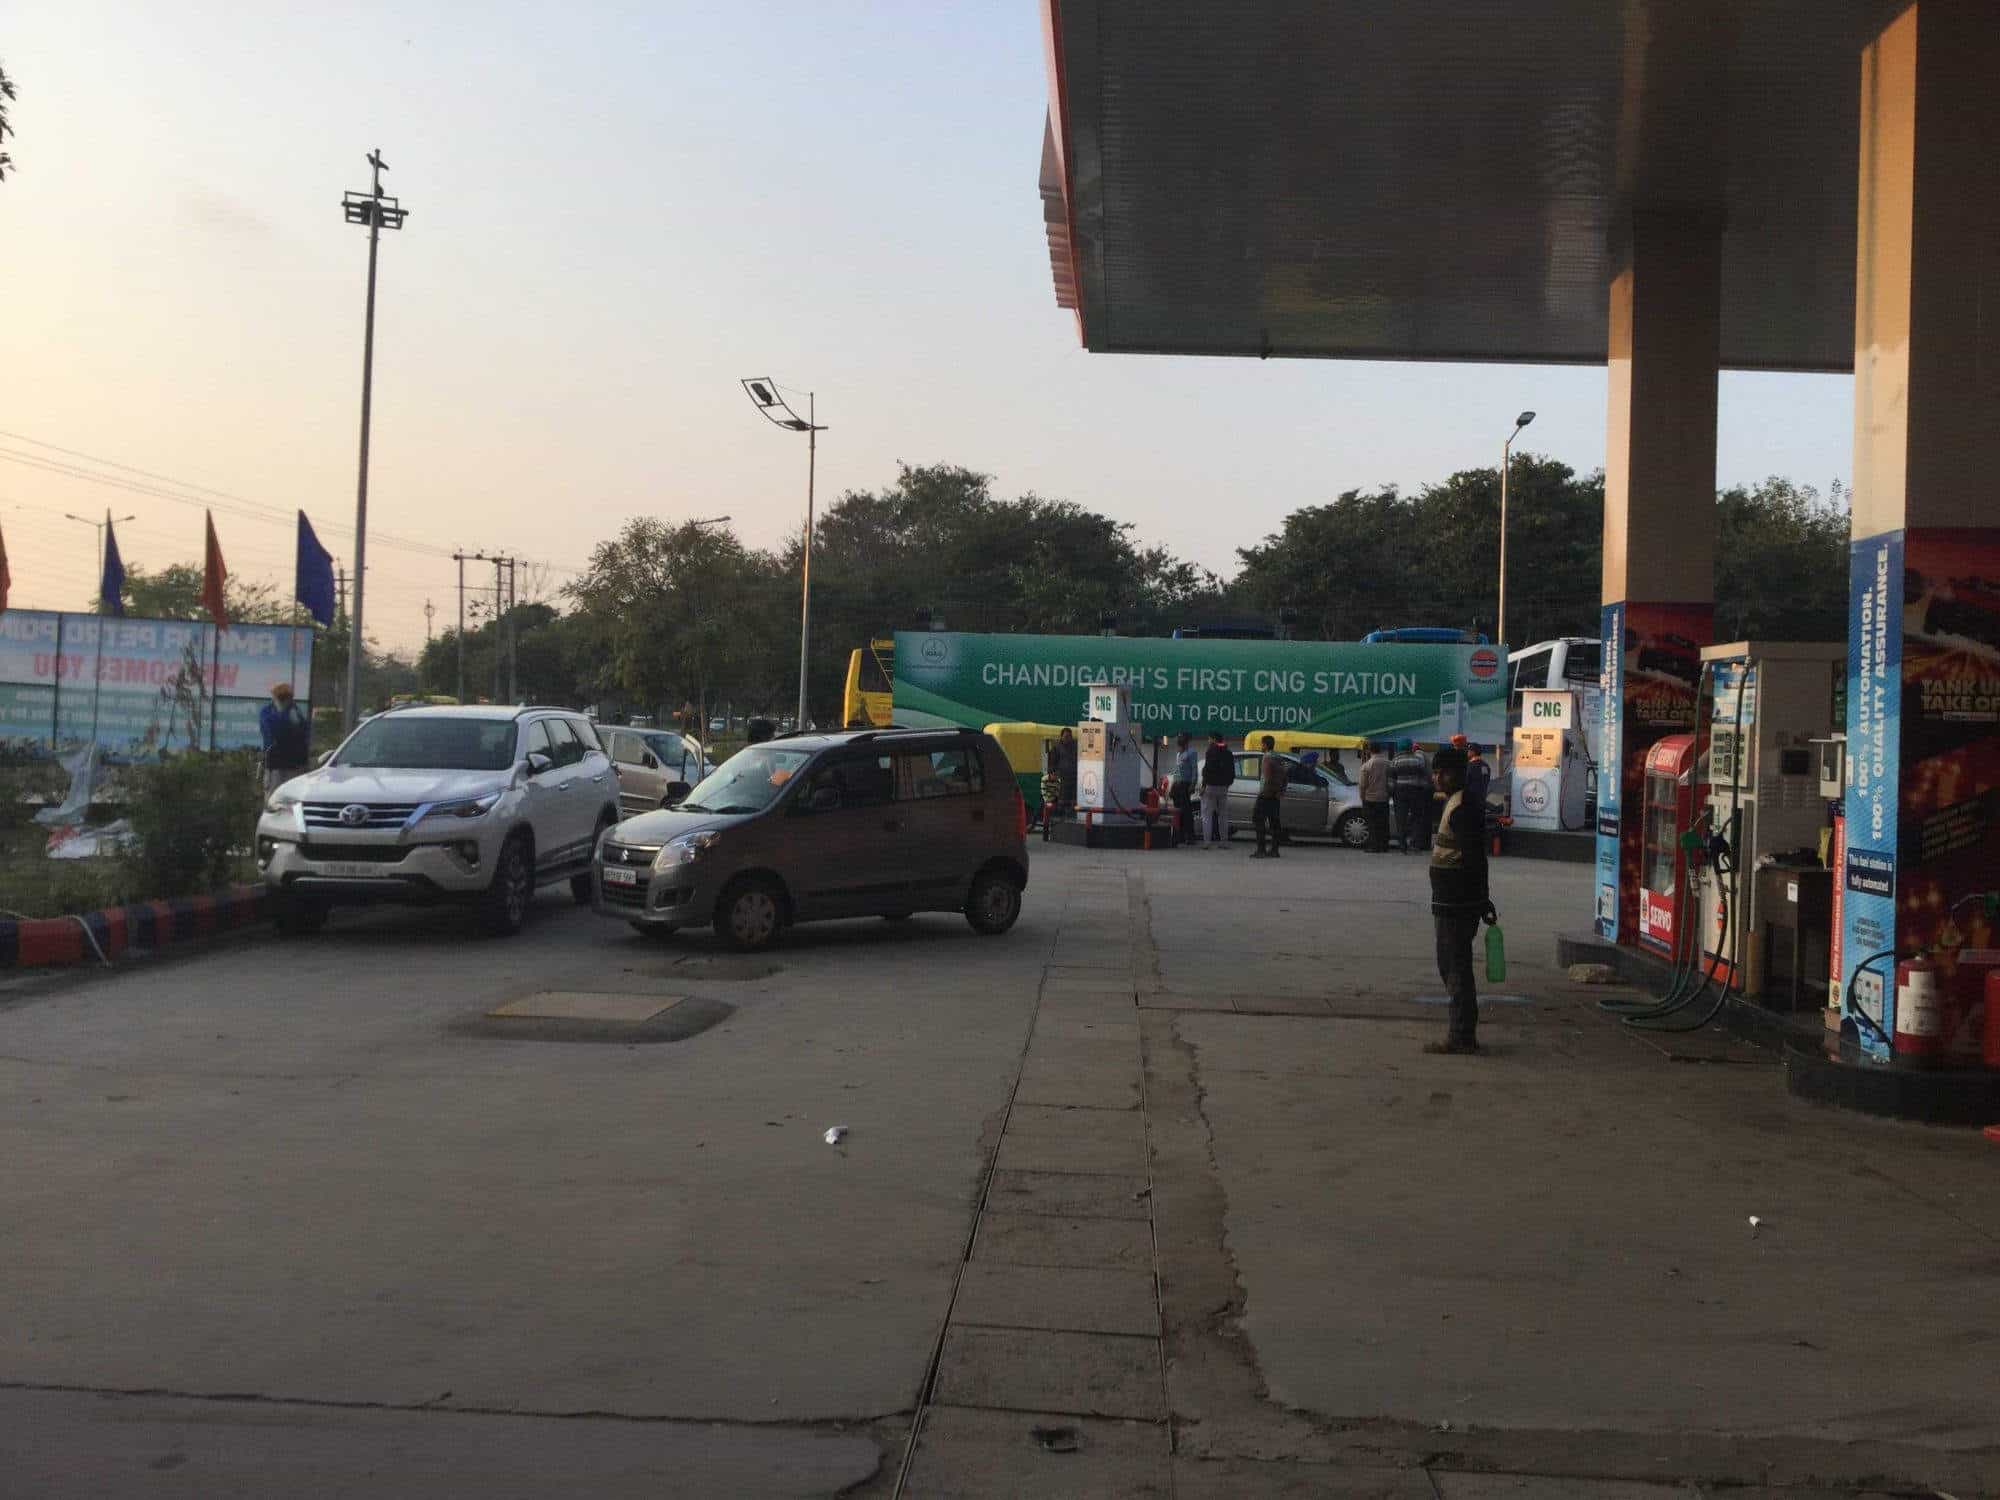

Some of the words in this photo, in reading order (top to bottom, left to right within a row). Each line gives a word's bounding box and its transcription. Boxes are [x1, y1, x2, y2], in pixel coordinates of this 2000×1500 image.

[1875, 543, 1889, 679] ASSURANCE.
[982, 662, 1169, 690] CHANDIGARH'S
[1178, 667, 1247, 691] FIRST
[1254, 669, 1305, 693] CNG
[1313, 671, 1416, 695] STATION
[1860, 586, 1873, 736] AUTOMATION.
[1081, 703, 1173, 722] STION
[1179, 705, 1201, 721] TO
[1208, 705, 1312, 724] POLLUTION
[1095, 695, 1111, 712] CNG
[1533, 701, 1561, 717] CNG
[1872, 686, 1886, 779] QUALITY
[1858, 742, 1870, 798] 100%
[1872, 784, 1884, 841] 100%
